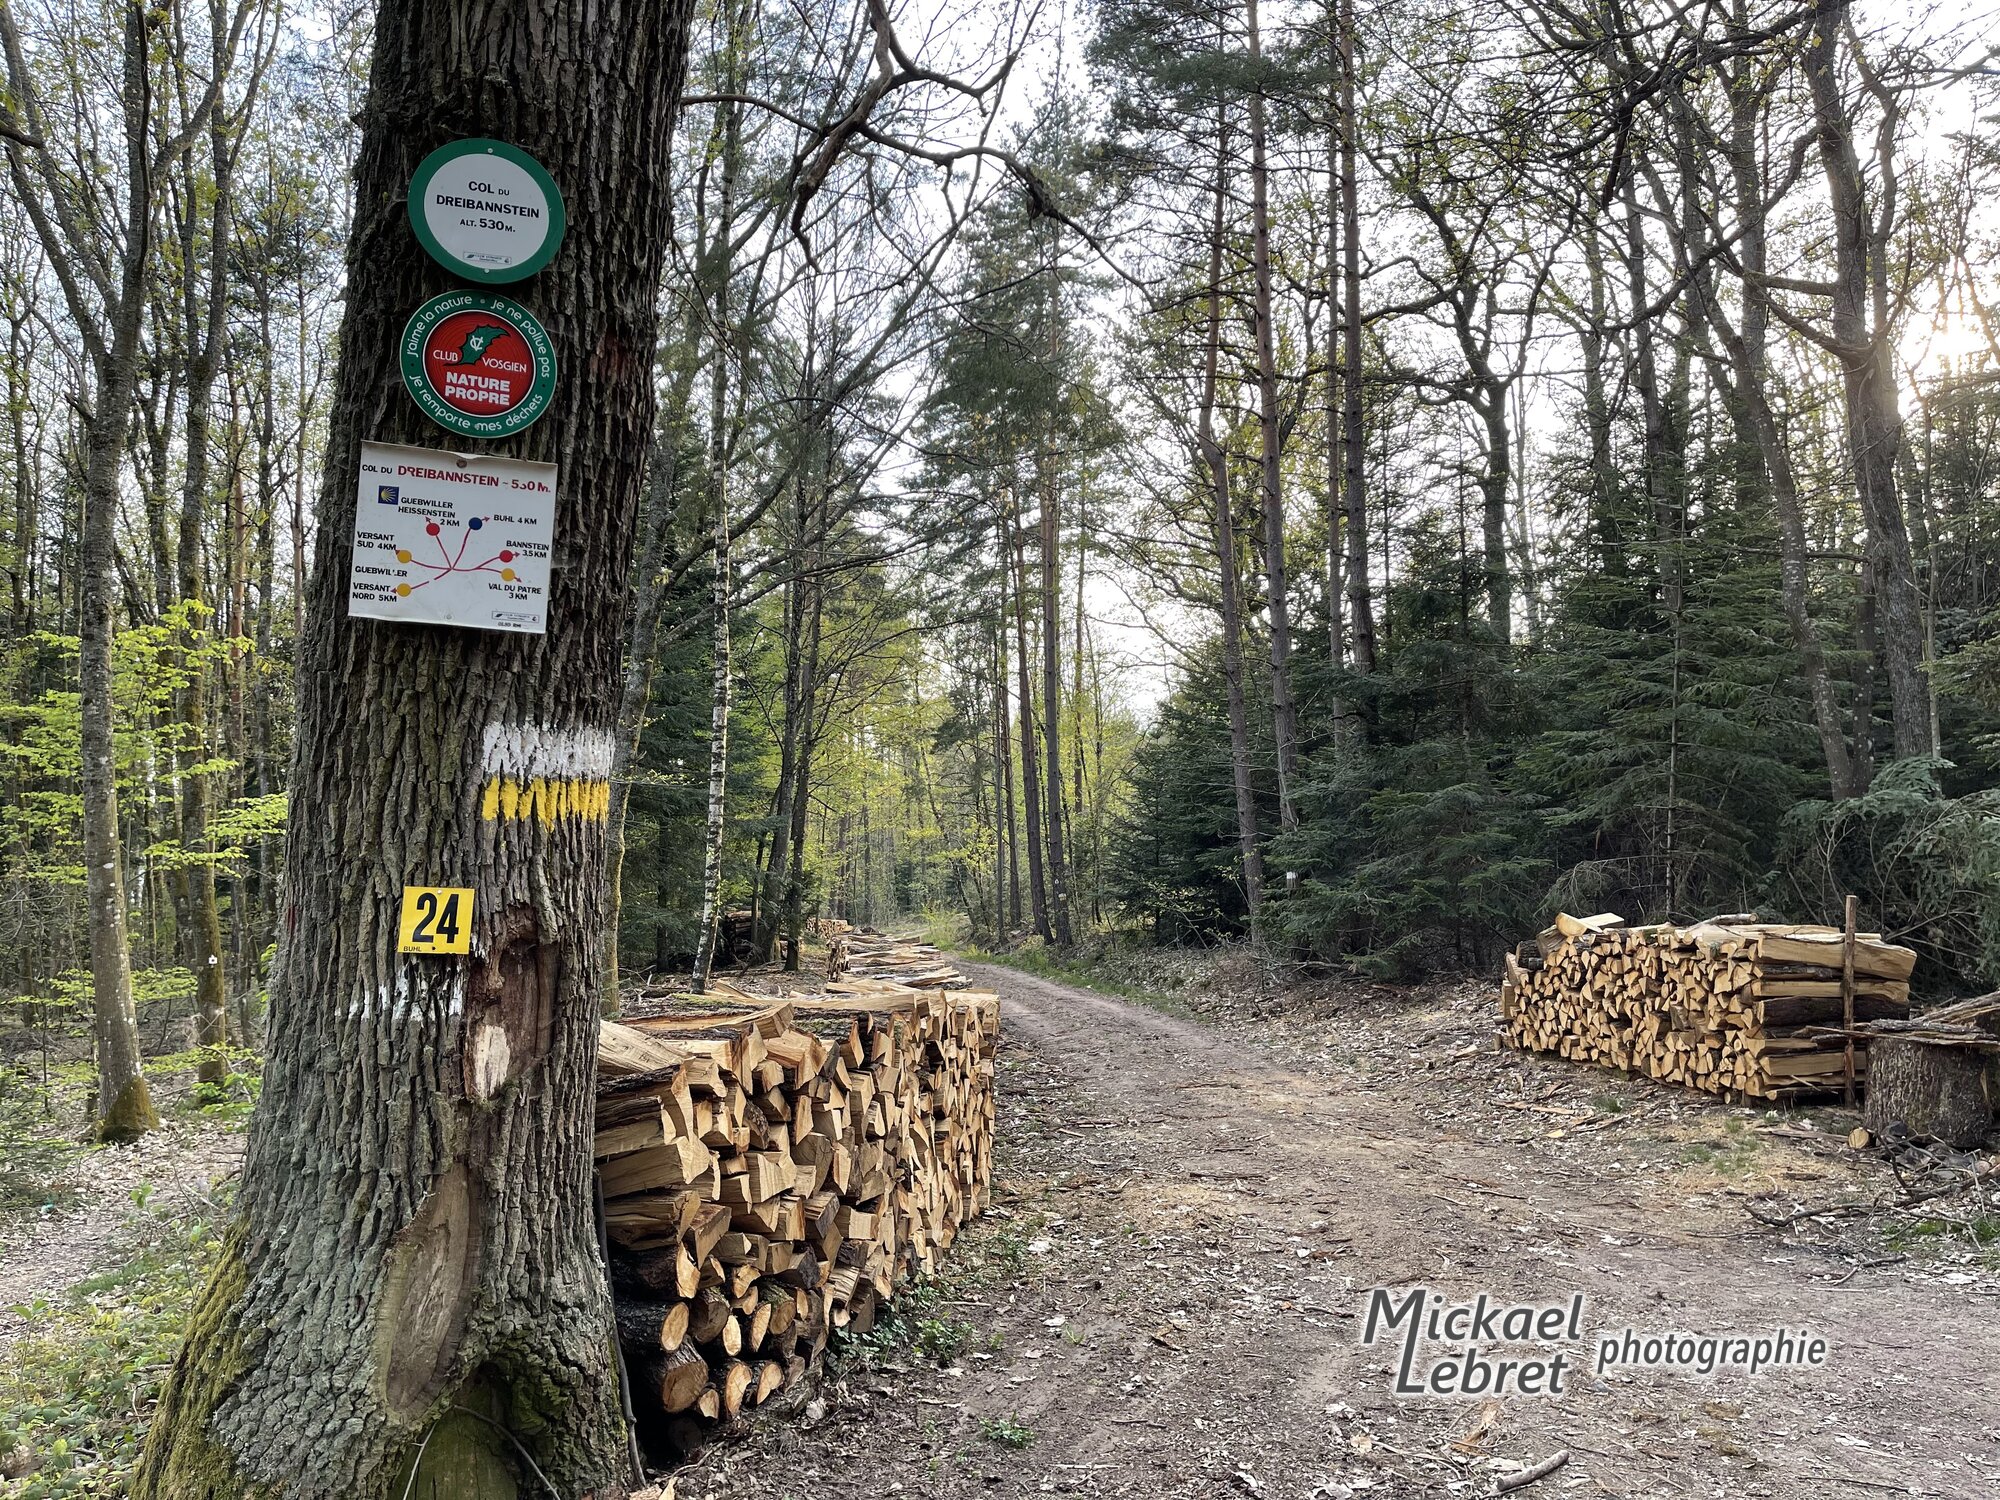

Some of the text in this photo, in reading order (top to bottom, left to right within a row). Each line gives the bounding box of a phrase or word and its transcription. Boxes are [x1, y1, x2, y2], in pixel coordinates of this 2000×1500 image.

[468, 181, 494, 194] COL
[436, 194, 540, 218] DREIBANNSTEIN
[460, 218, 476, 227] ALT.
[422, 310, 435, 323] la
[434, 296, 472, 314] nature
[506, 306, 522, 320] ne
[520, 320, 546, 354] pollue
[538, 356, 550, 378] pas
[433, 350, 527, 372] CLUB VOSGIEN
[446, 372, 510, 392] NATURE
[444, 386, 510, 406] PROPRE
[418, 388, 470, 429] remporte
[477, 421, 502, 432] mes
[505, 394, 542, 427] déchets
[362, 464, 378, 472] COL
[398, 466, 499, 487] DREIBANNSTEIN
[400, 497, 453, 508] GUEBWILLER
[398, 506, 456, 518] HEISSENSTEIN
[494, 514, 514, 522] BUHL
[357, 532, 394, 541] VERSANT
[506, 540, 549, 550] BANNSTEIN
[353, 582, 390, 592] VERSANT
[488, 583, 502, 591] VAL
[517, 586, 542, 594] PATRE
[352, 592, 375, 601] NORD
[412, 892, 459, 944] 24
